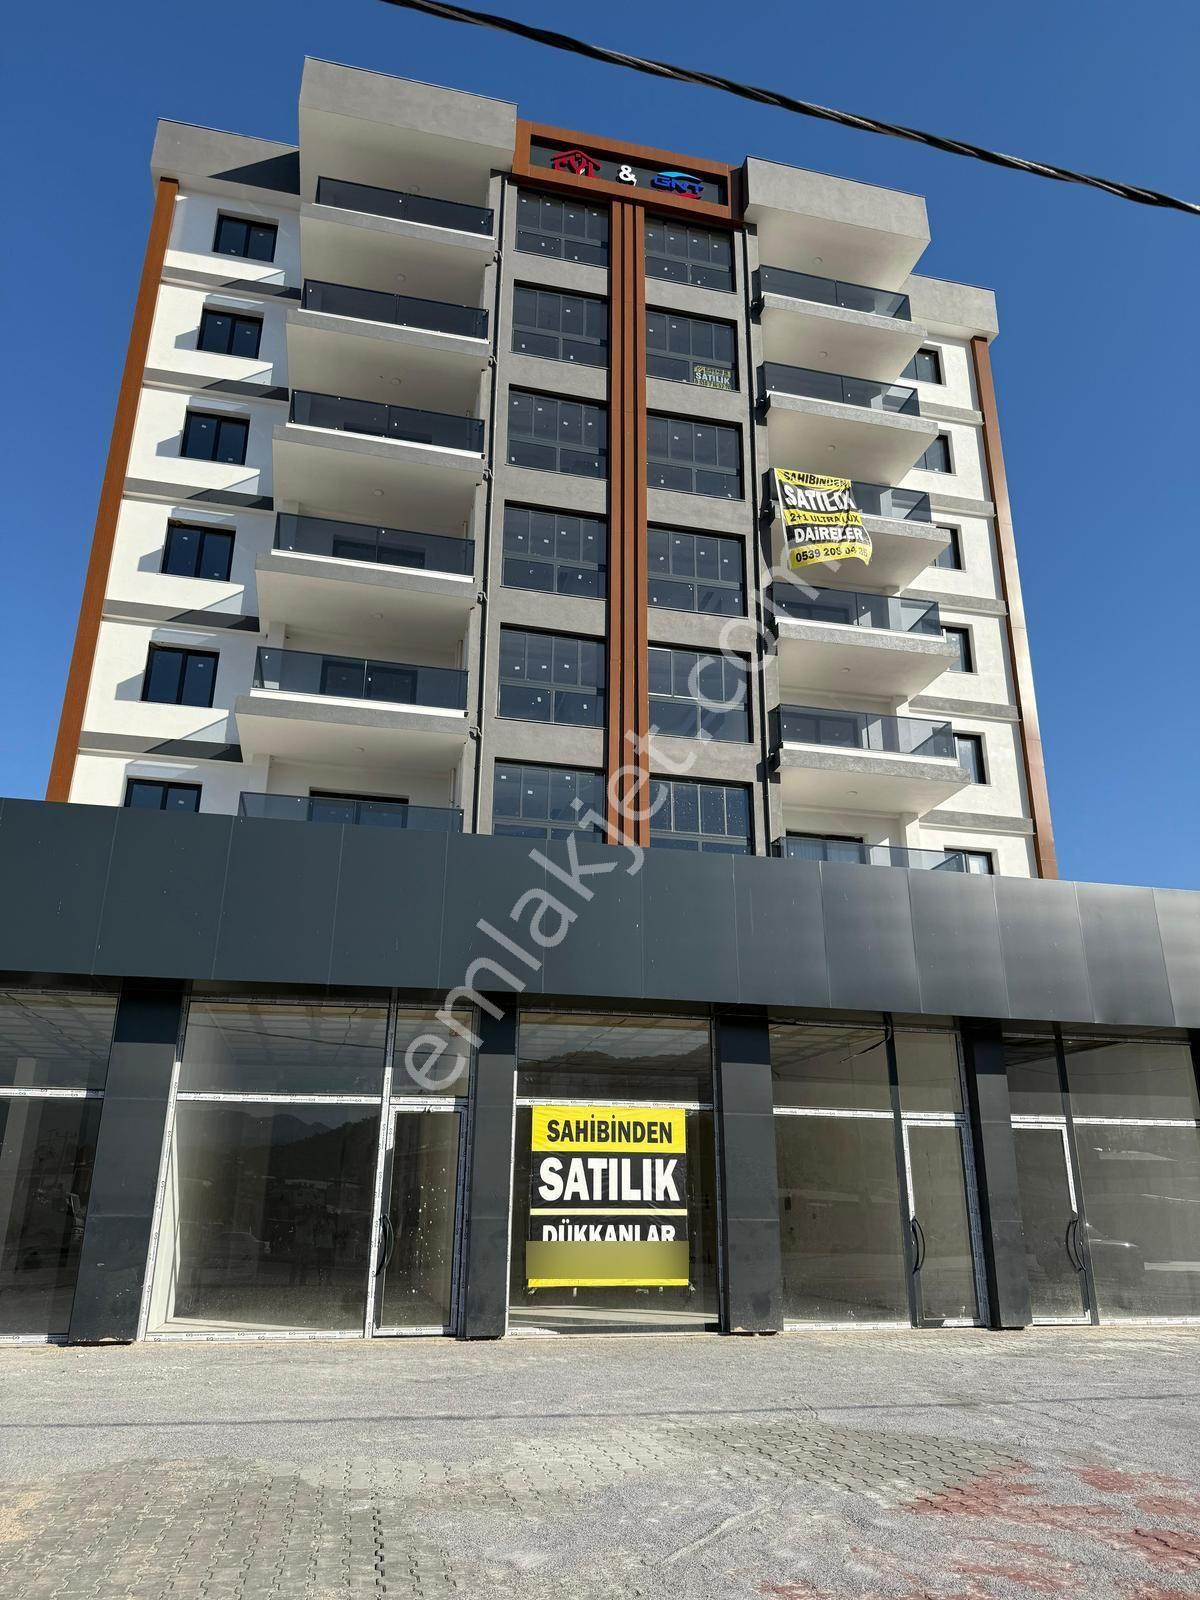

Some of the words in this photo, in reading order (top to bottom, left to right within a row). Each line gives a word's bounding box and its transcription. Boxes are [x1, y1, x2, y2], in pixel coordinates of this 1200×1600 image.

[619, 165, 637, 186] &
[695, 372, 730, 385] SATILIK
[790, 512, 808, 523] 2+1
[810, 514, 840, 524] ULTRA
[795, 548, 820, 563] 0539
[546, 1113, 673, 1144] SAHİBİNDEN
[537, 1156, 681, 1202] SATILIK
